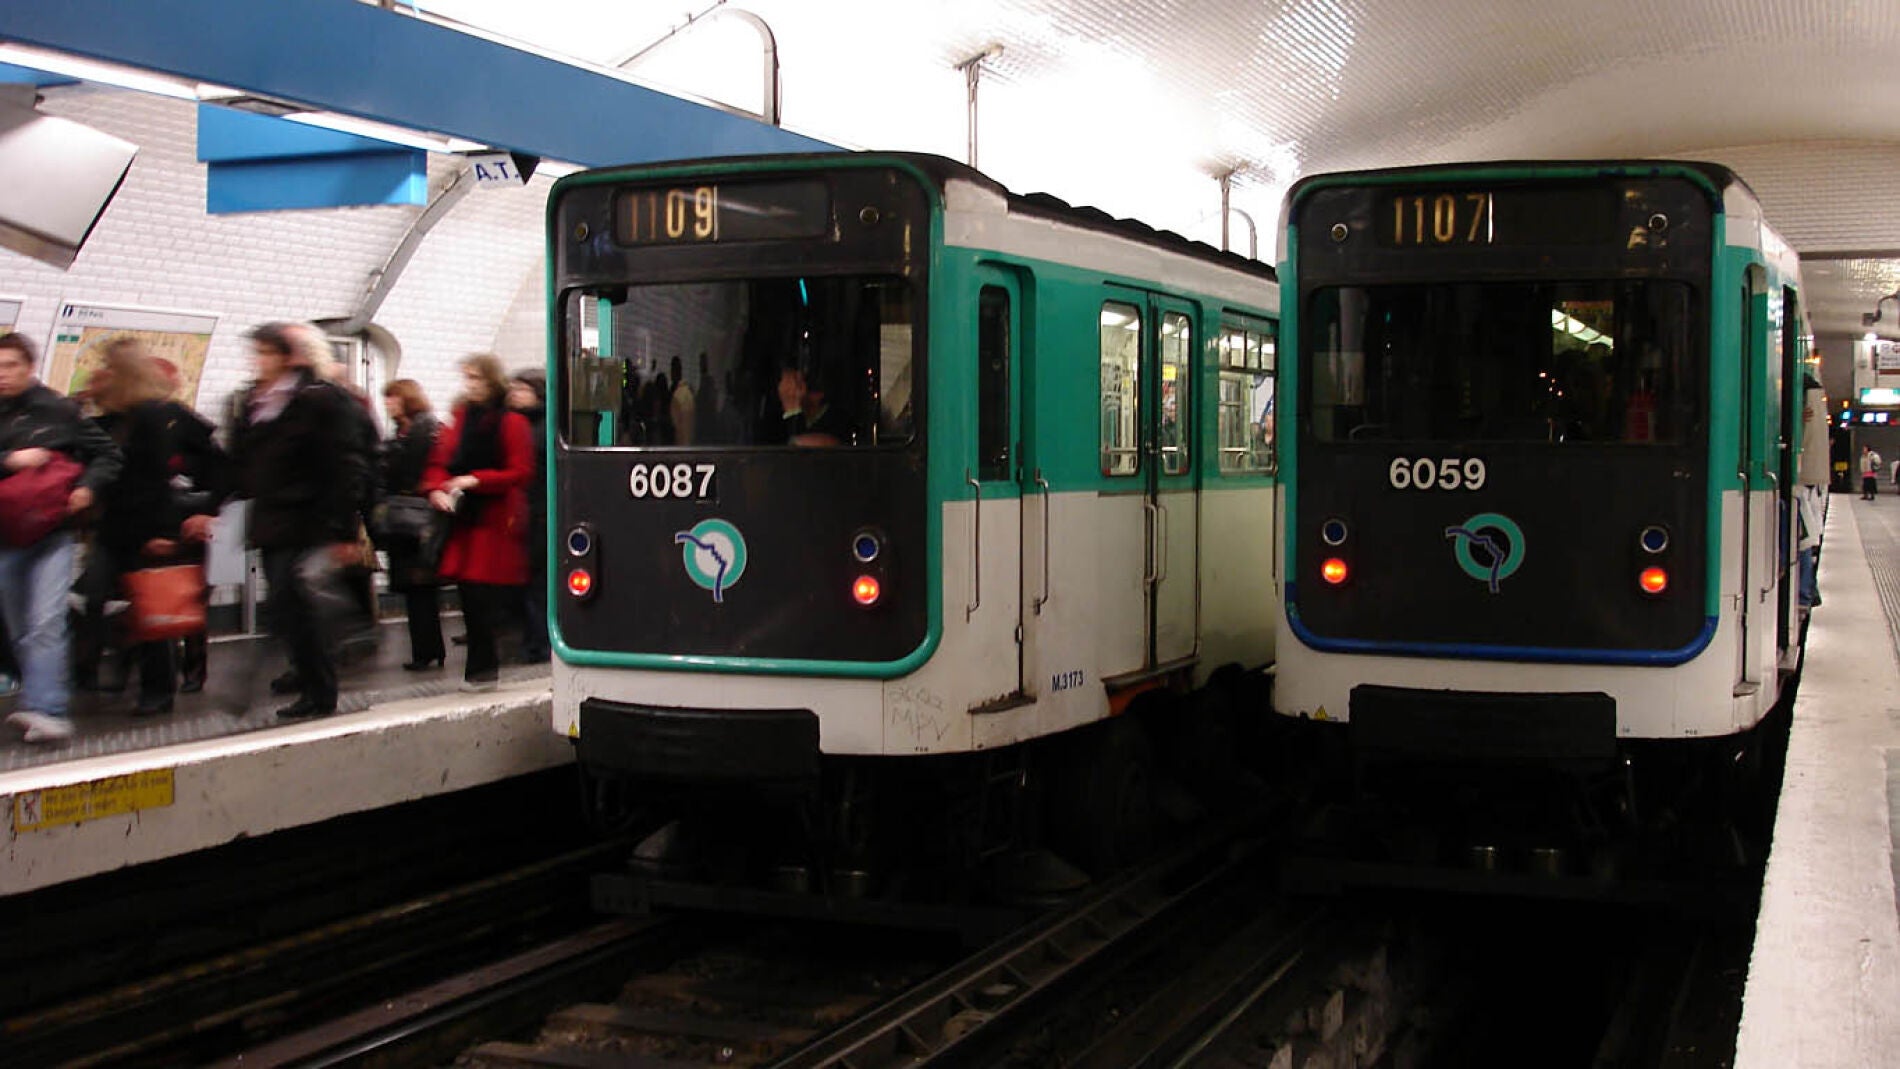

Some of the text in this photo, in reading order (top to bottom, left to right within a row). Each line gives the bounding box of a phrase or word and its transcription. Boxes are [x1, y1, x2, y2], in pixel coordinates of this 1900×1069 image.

[475, 162, 519, 181] A.T.
[629, 186, 713, 240] 1109
[1394, 192, 1486, 244] 1107
[630, 463, 715, 498] 6087
[1389, 457, 1486, 491] 6059
[1051, 670, 1084, 692] M.3173
